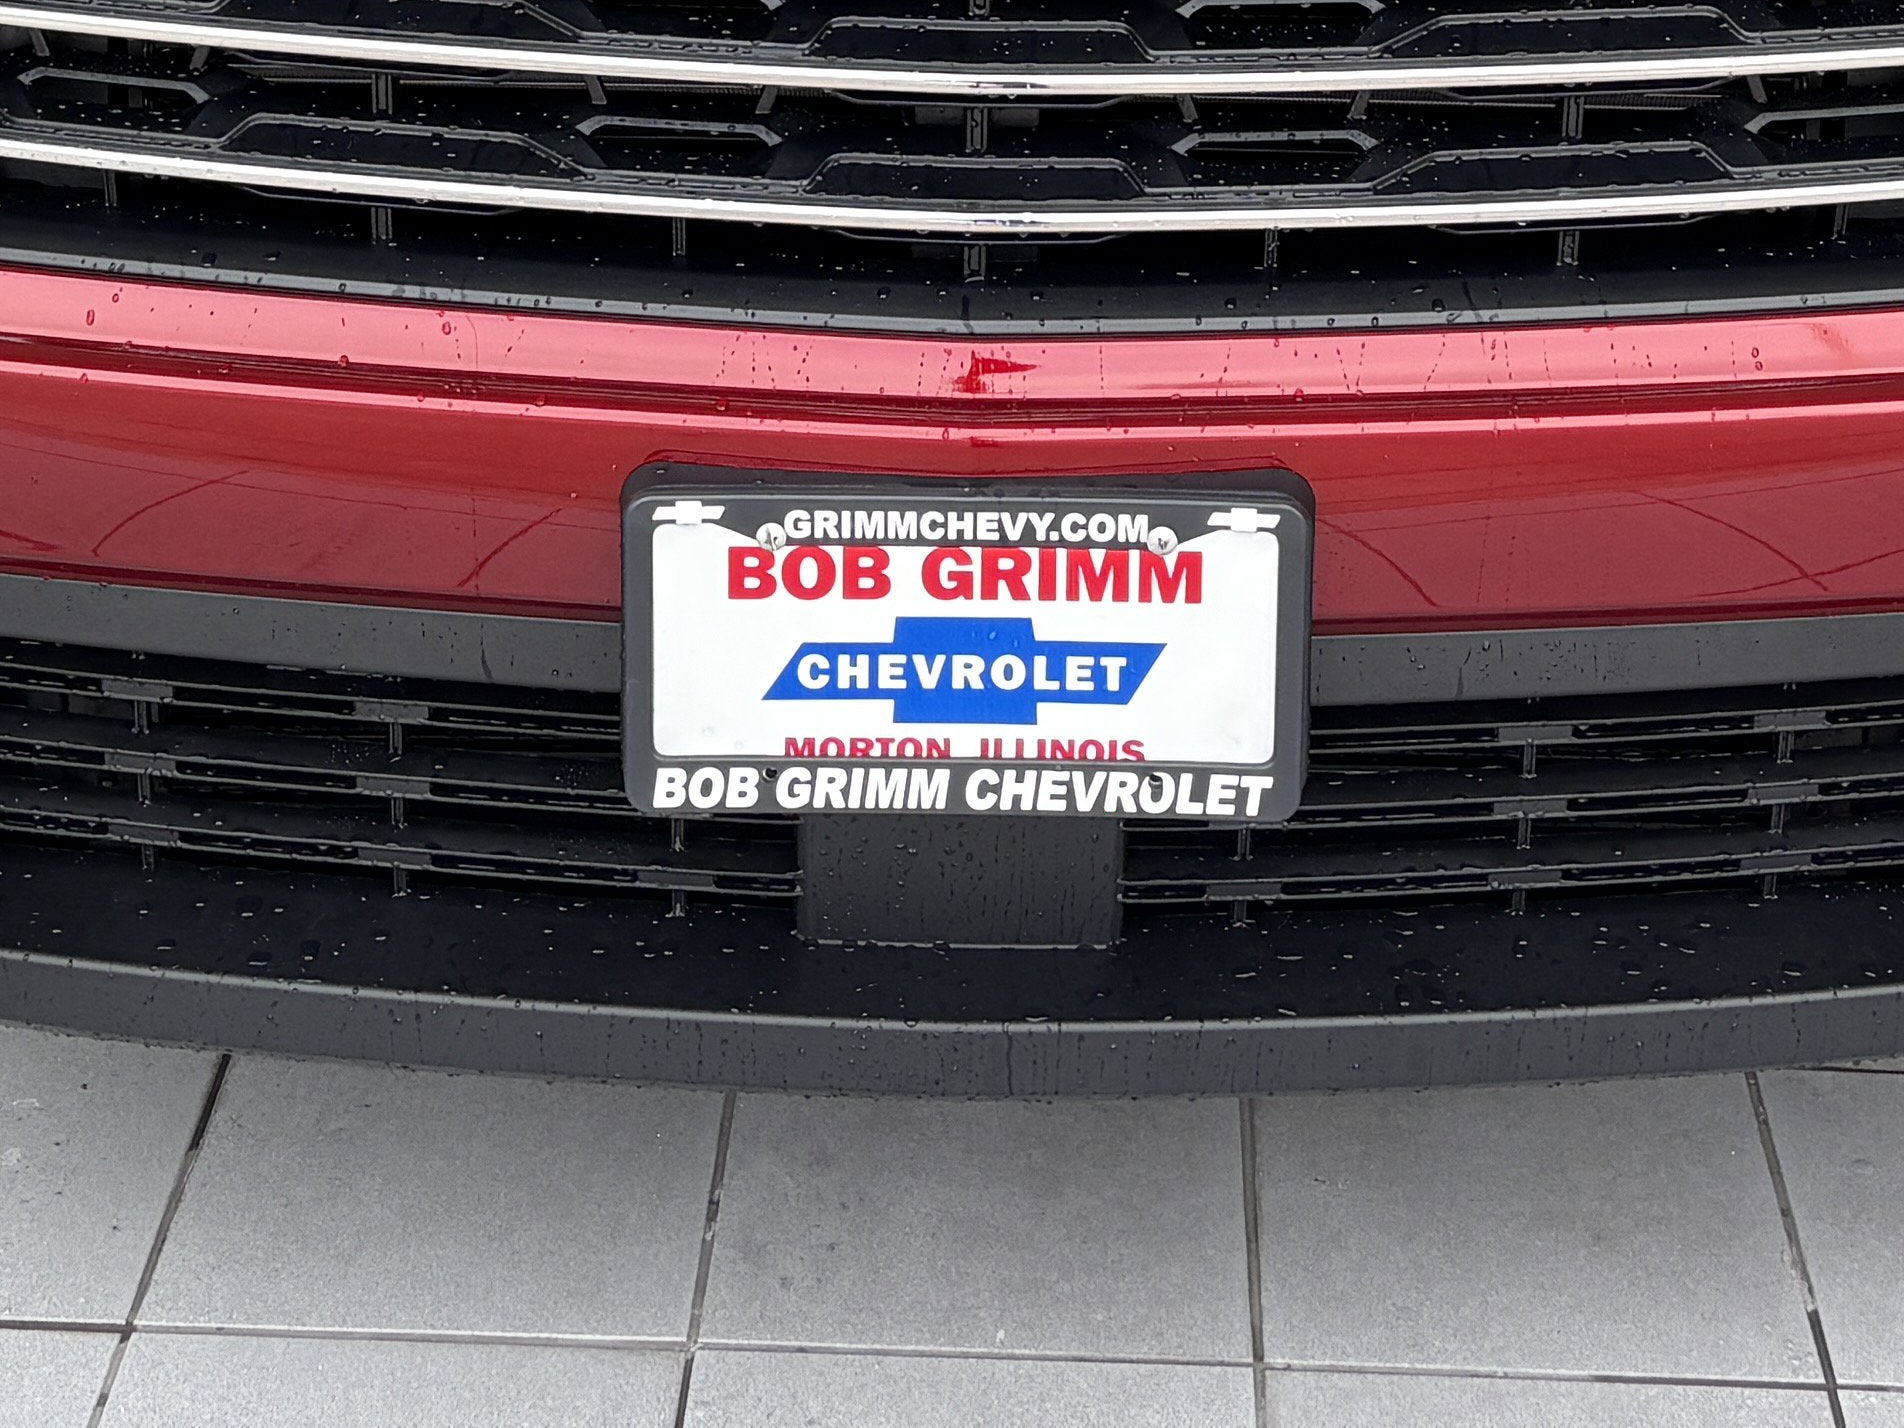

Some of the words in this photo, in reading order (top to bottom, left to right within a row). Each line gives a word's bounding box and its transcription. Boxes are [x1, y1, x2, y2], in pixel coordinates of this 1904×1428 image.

[782, 508, 1149, 544] GRIMMCHEVY.COM
[728, 546, 892, 601] BOB
[921, 546, 1203, 605] GRIMM
[796, 653, 1128, 692] CHEVROLET
[652, 766, 759, 810] BOB
[775, 767, 951, 812] GRIMM
[964, 769, 1274, 818] CHEVROLET
